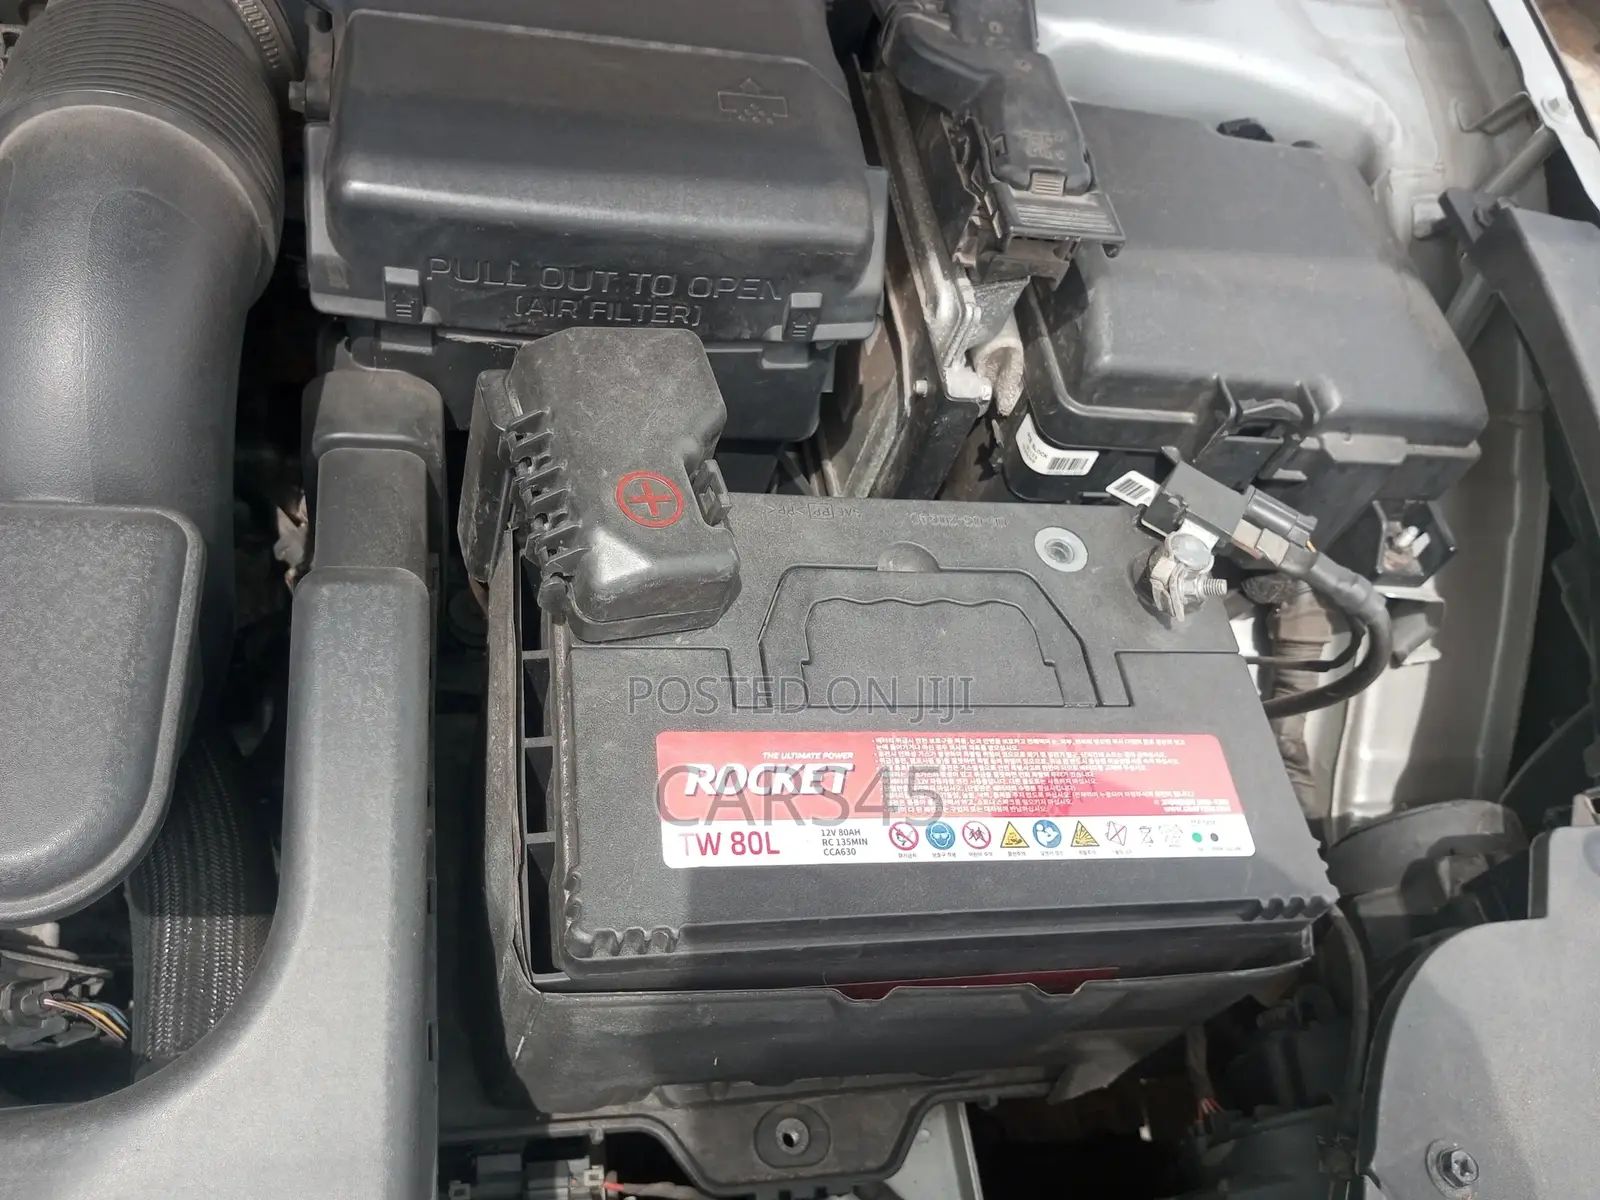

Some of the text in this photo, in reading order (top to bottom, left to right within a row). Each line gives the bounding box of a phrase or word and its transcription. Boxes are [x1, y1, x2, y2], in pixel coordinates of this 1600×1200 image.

[426, 257, 783, 302] PULL OUT TO OPEN
[762, 751, 854, 760] THE ULTIMATE POWER
[684, 762, 856, 797] ROCKET
[821, 828, 861, 838] 12V 80AH
[678, 830, 780, 857] TW 80L
[822, 837, 869, 847] RC 135MIN
[823, 847, 857, 857] CCA630
